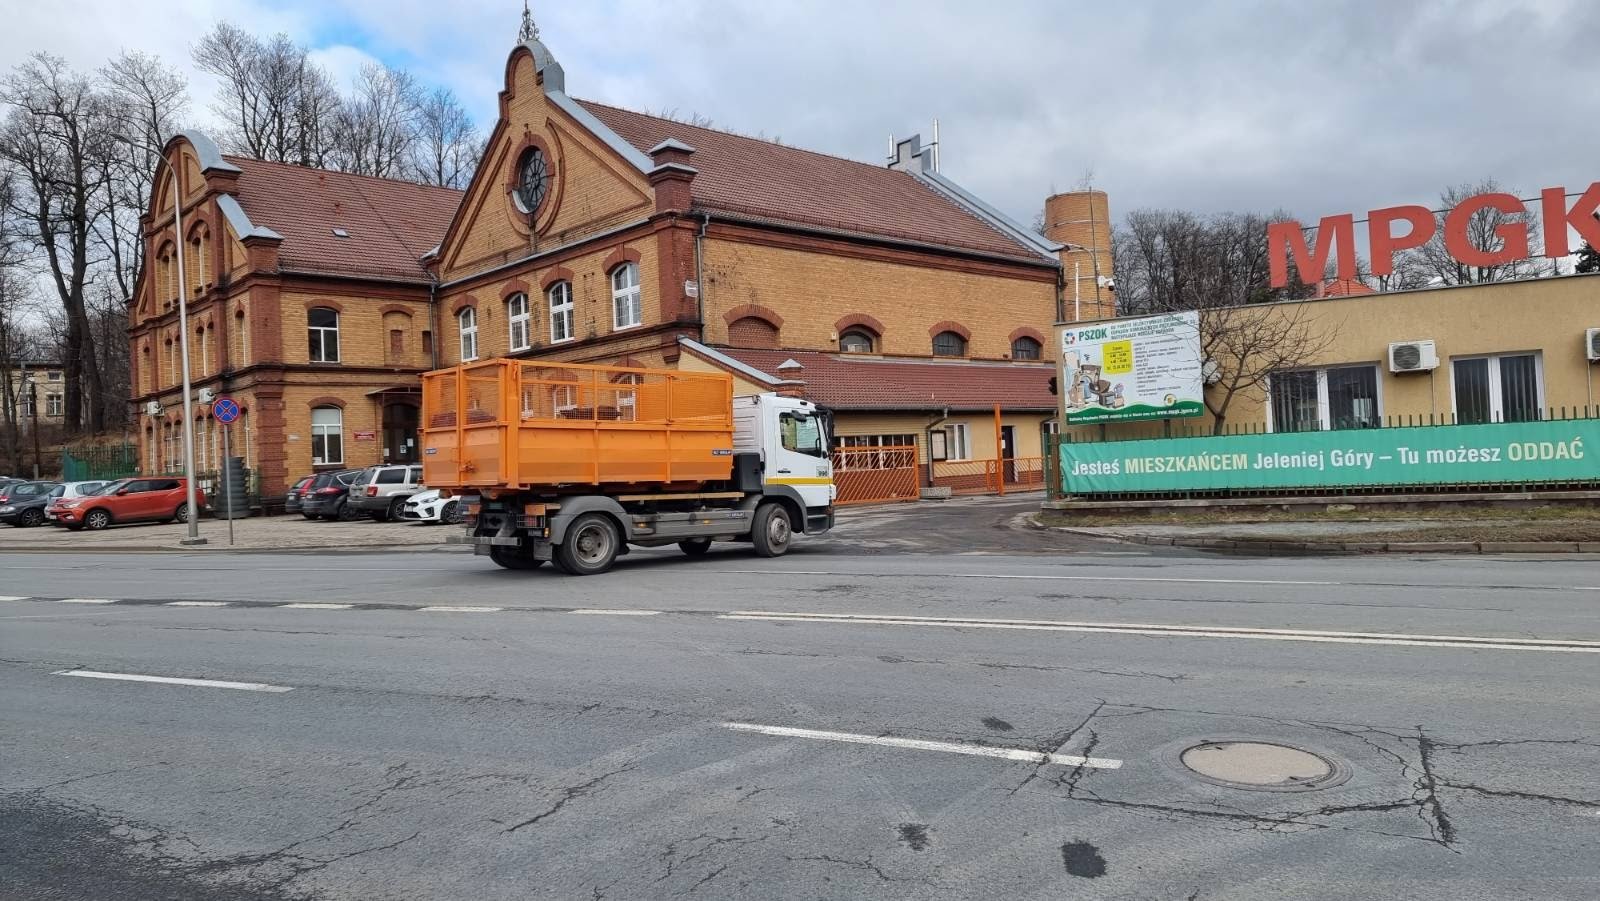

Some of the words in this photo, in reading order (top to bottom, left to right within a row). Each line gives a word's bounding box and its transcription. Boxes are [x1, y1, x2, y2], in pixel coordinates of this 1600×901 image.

[1267, 181, 1600, 288] MPGK
[1079, 328, 1107, 341] PSZOK
[1072, 459, 1120, 476] Jesteś
[1125, 451, 1248, 474] MIESZKAŃCEM
[1253, 451, 1325, 471] Jeleniej
[1330, 449, 1374, 470] Góry
[1397, 447, 1419, 465] Tu
[1427, 445, 1502, 464] możesz
[1508, 437, 1584, 462] ODDAĆ
